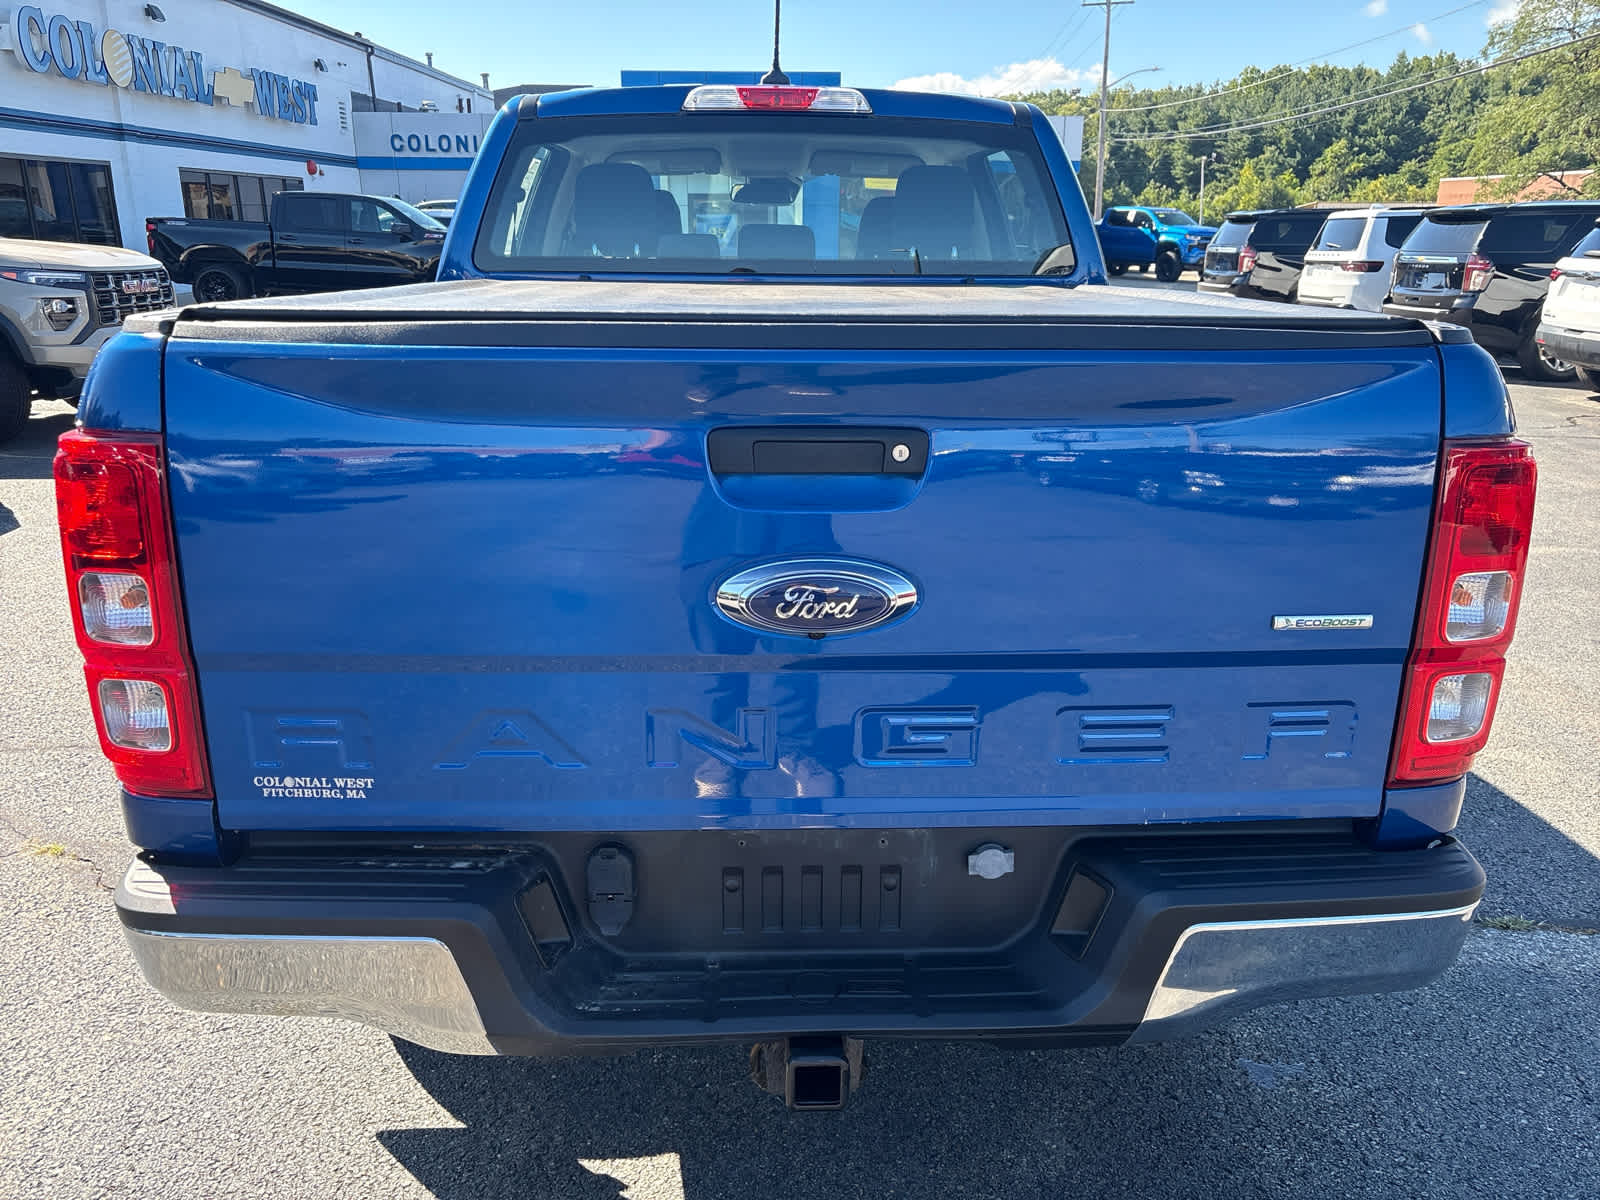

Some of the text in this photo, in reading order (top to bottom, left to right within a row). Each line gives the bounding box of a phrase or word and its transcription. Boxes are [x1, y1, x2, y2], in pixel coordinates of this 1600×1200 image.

[17, 5, 319, 126] COLONIAL WEST
[122, 278, 159, 294] GMC
[775, 585, 860, 619] Ford
[246, 701, 1357, 770] RANGER
[253, 776, 375, 789] COLONIAL WEST
[263, 788, 367, 799] FITCHBURG, MA
